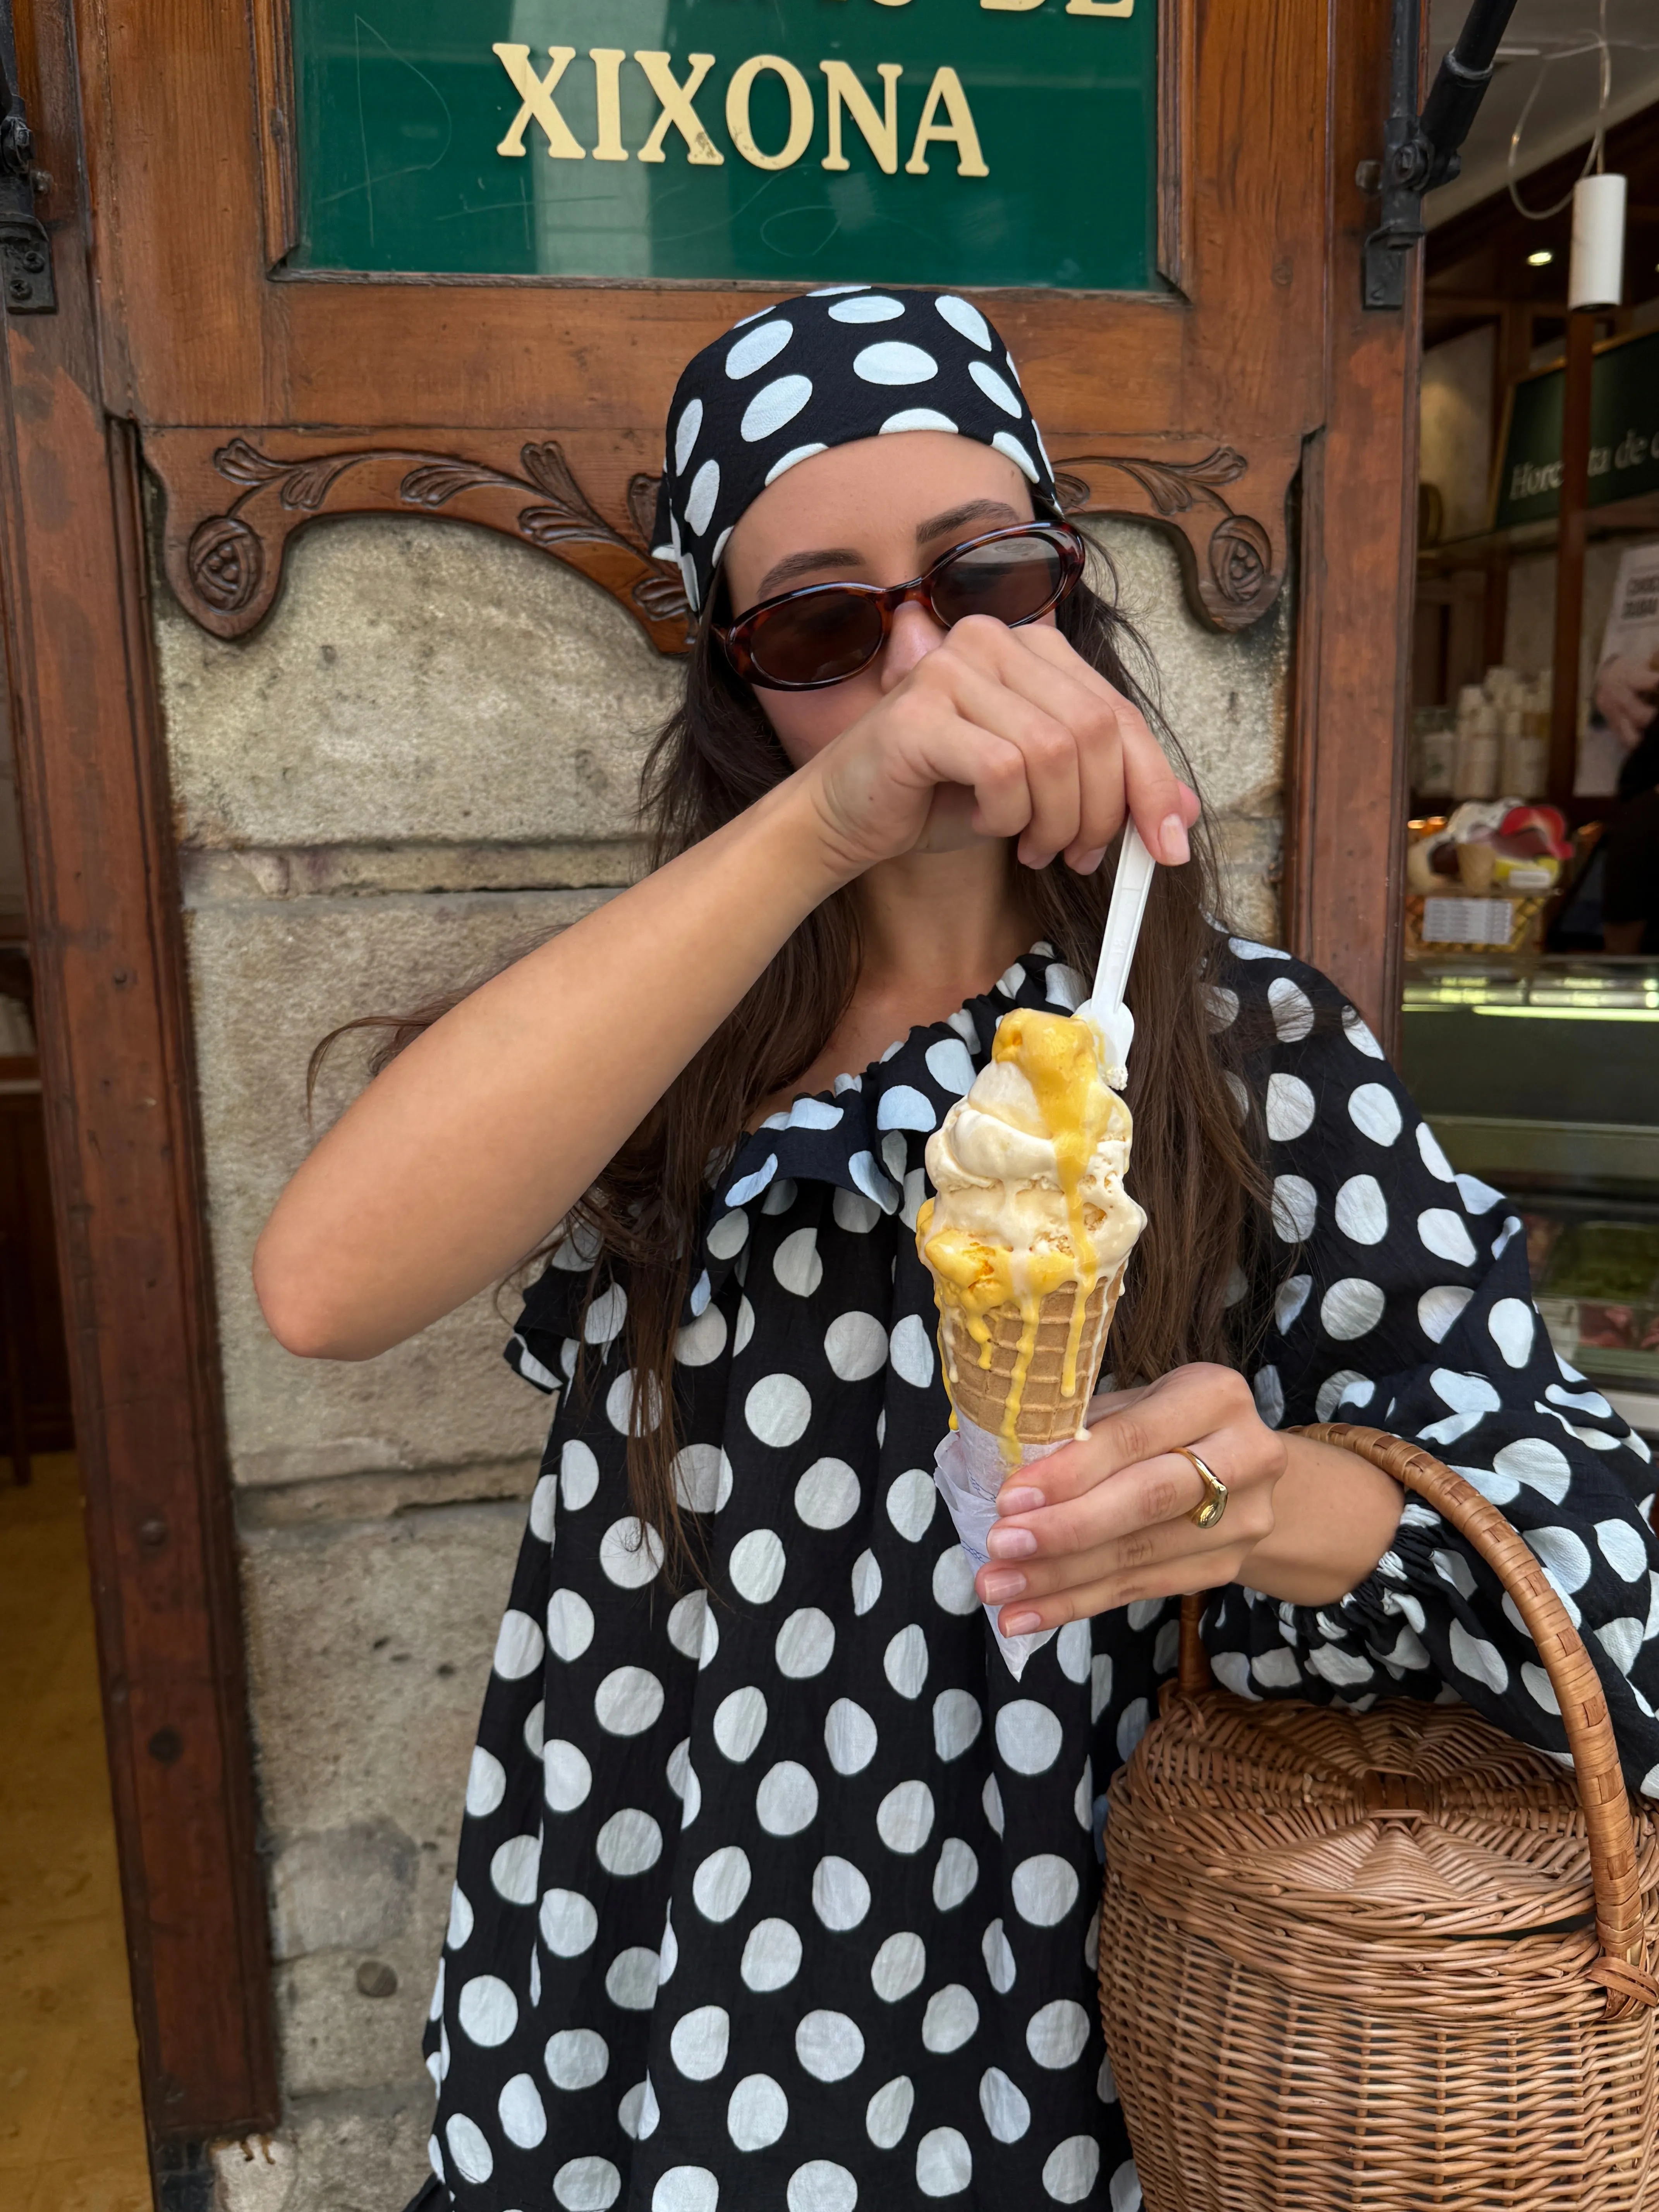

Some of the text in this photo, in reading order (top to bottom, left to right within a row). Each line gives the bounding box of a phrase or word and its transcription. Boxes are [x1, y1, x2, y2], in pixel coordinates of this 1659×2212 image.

[492, 43, 989, 177] XIXONA
[1510, 446, 1612, 500] Horcta
[1614, 429, 1649, 469] de
